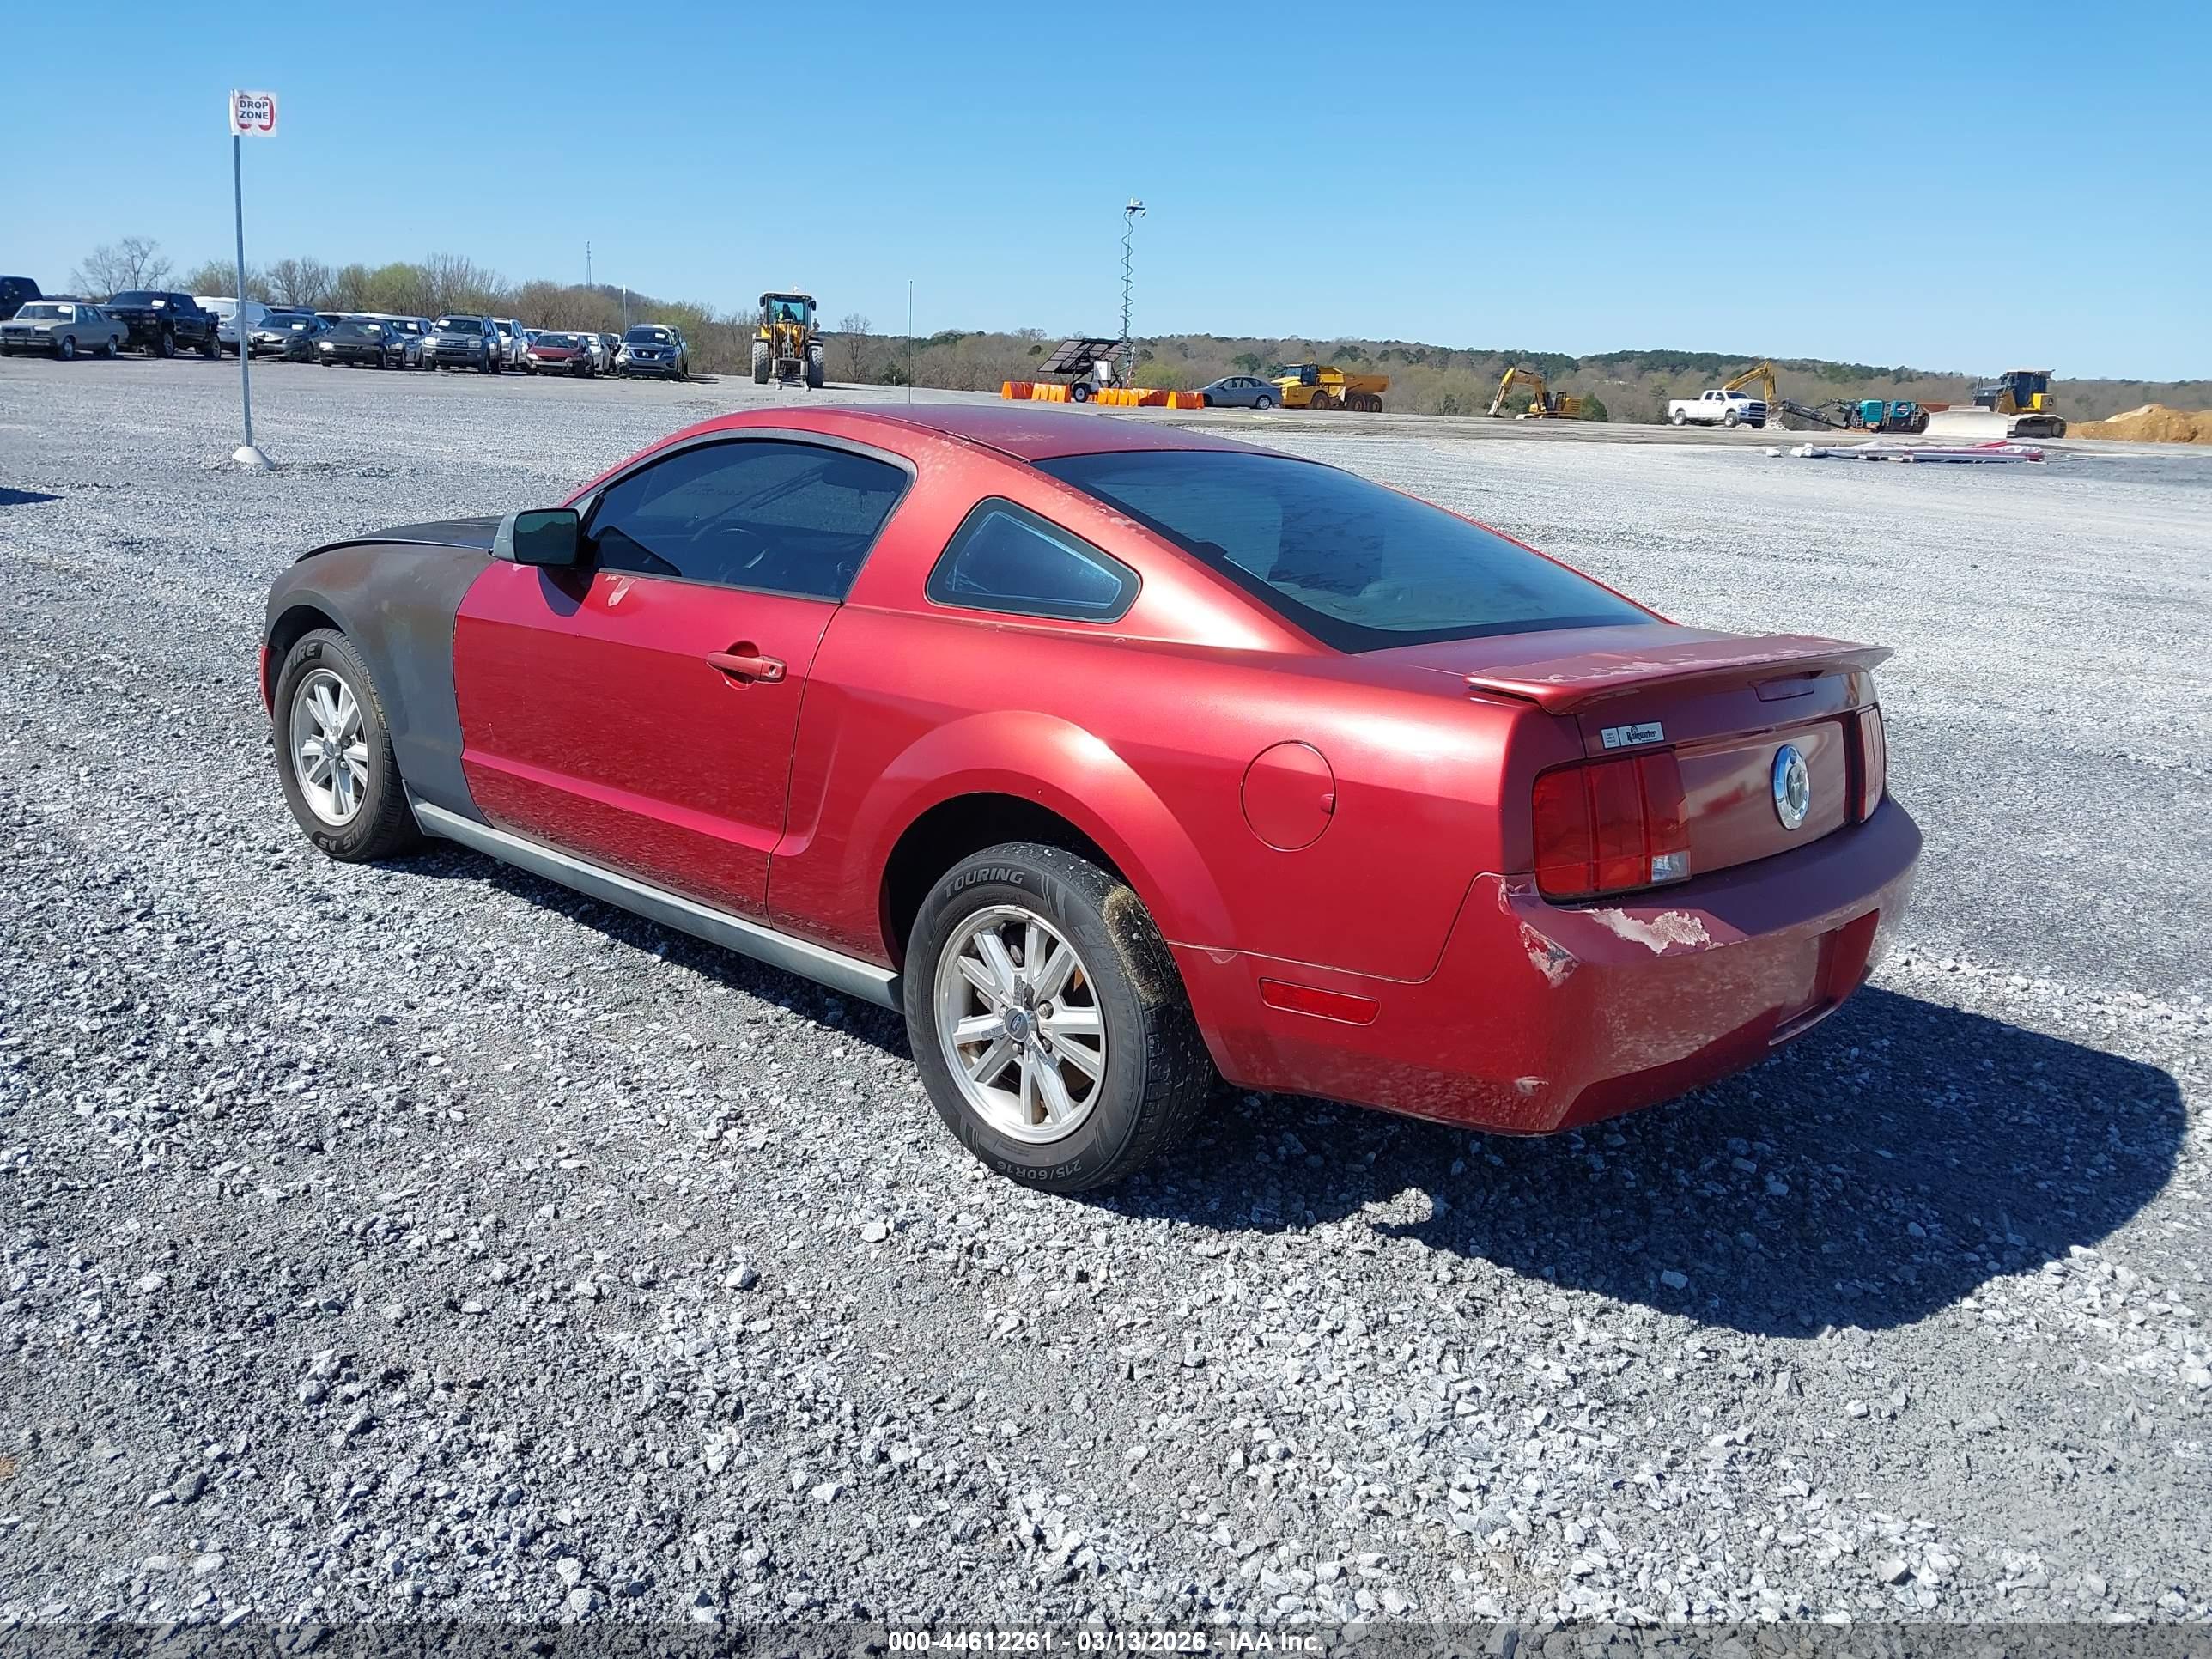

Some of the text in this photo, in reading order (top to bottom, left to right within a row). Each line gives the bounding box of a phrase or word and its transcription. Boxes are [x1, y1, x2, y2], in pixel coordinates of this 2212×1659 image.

[240, 100, 269, 109] DROP
[240, 111, 269, 119] ZONE
[945, 868, 1026, 898] TOURING
[996, 1158, 1082, 1180] 215/60R16
